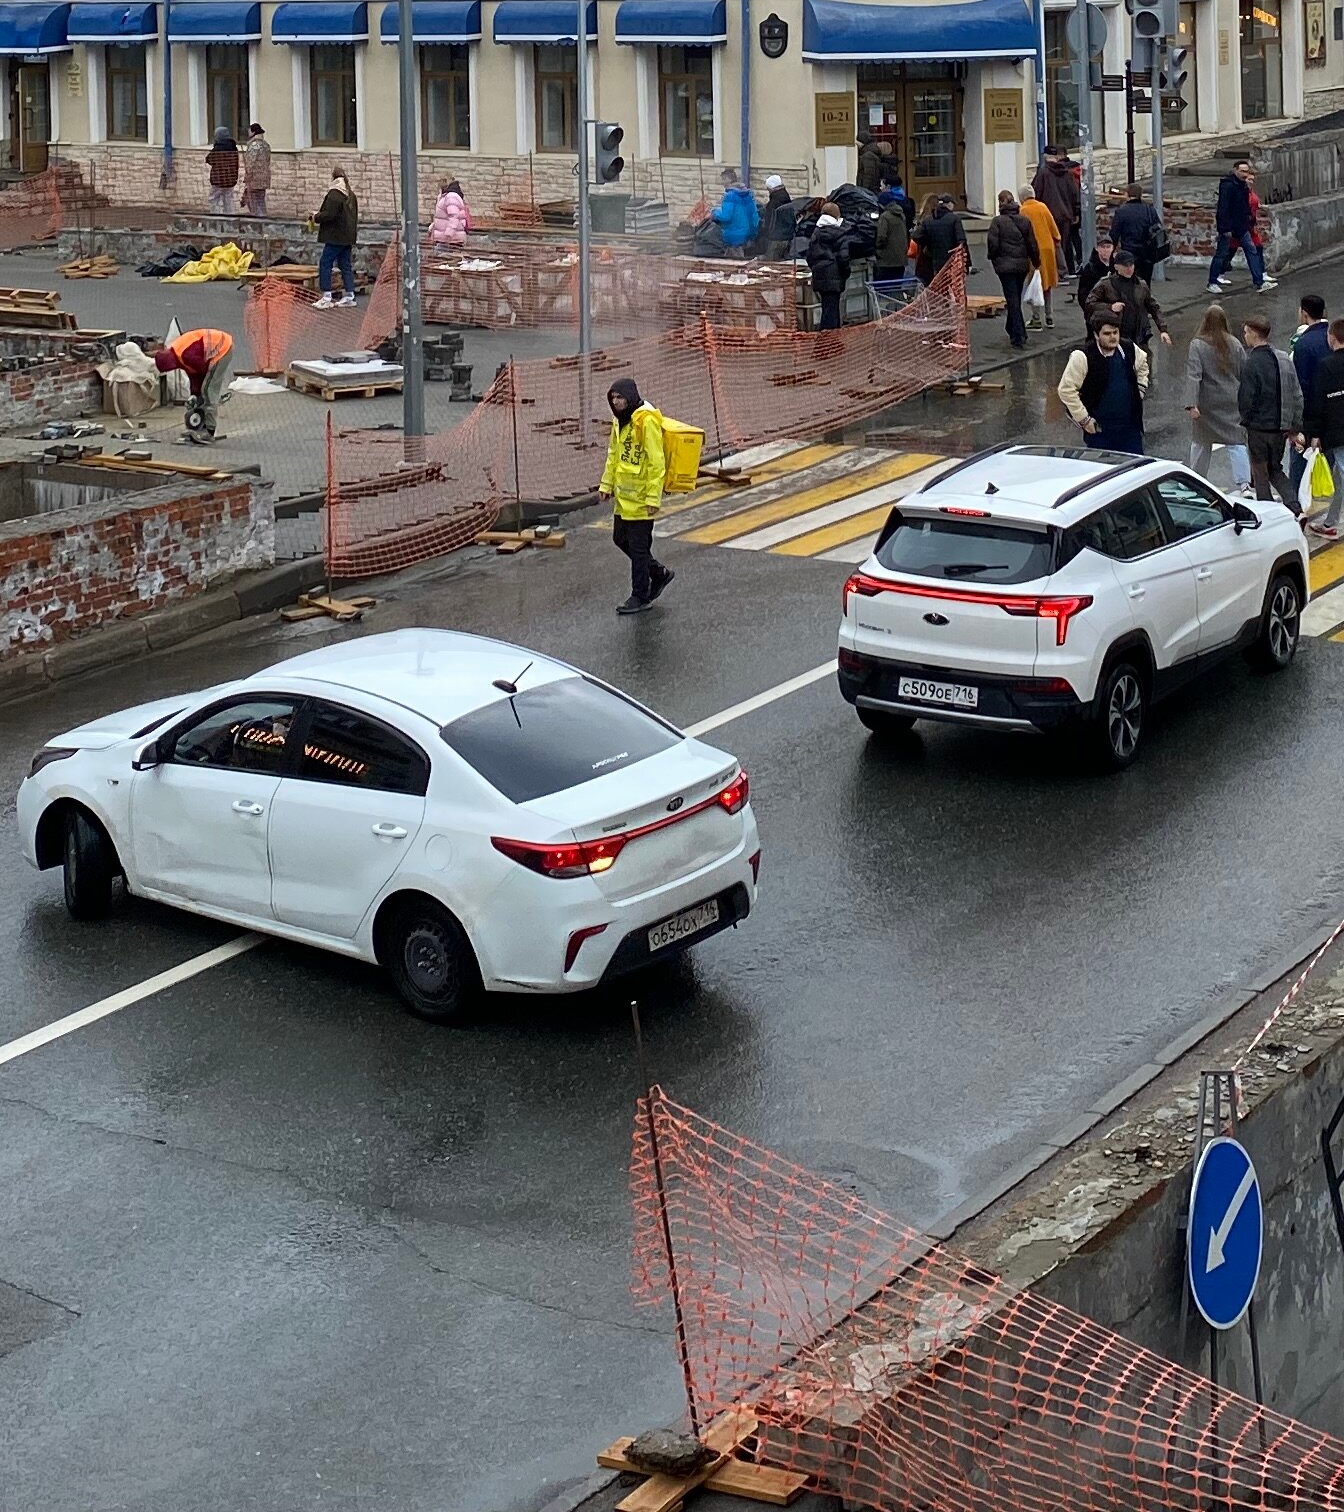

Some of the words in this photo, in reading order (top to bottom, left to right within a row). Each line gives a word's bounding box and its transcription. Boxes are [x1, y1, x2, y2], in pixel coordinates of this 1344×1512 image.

[821, 111, 850, 123] 10-21
[990, 106, 1018, 118] 10-21
[902, 680, 952, 700] С509ОЕ
[955, 687, 974, 700] 716
